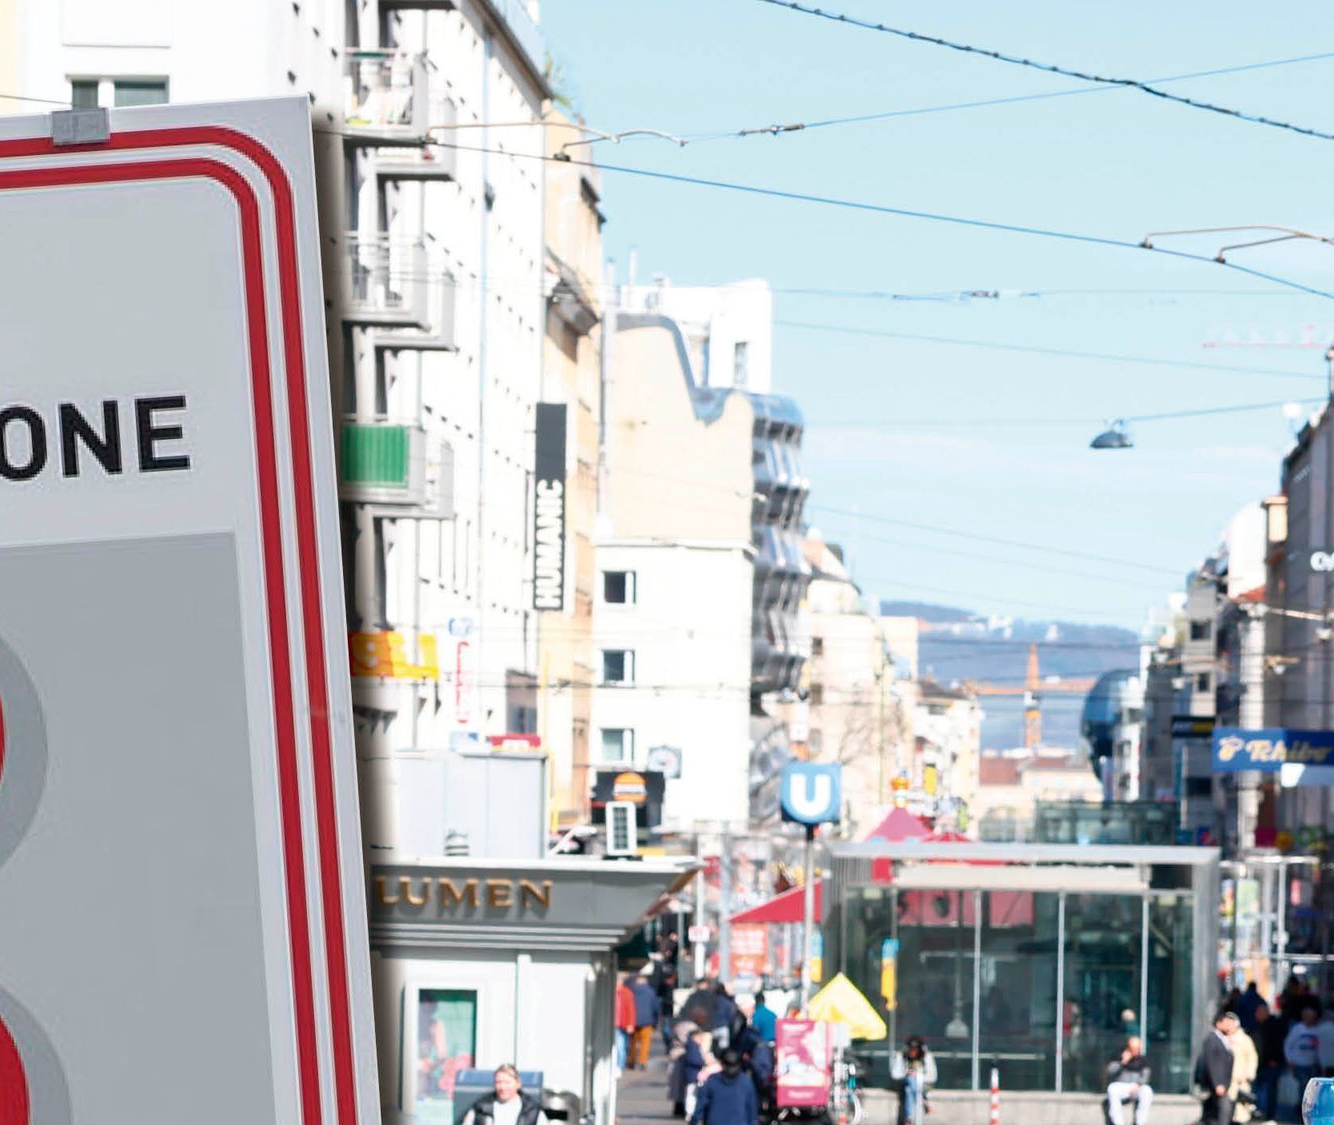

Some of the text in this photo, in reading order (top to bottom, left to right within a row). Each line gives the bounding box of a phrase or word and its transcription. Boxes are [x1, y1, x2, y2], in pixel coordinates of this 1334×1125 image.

[535, 478, 565, 609] HUMANIC
[1245, 738, 1334, 762] Tchibo
[789, 773, 832, 818] U
[375, 875, 554, 909] LUMEN
